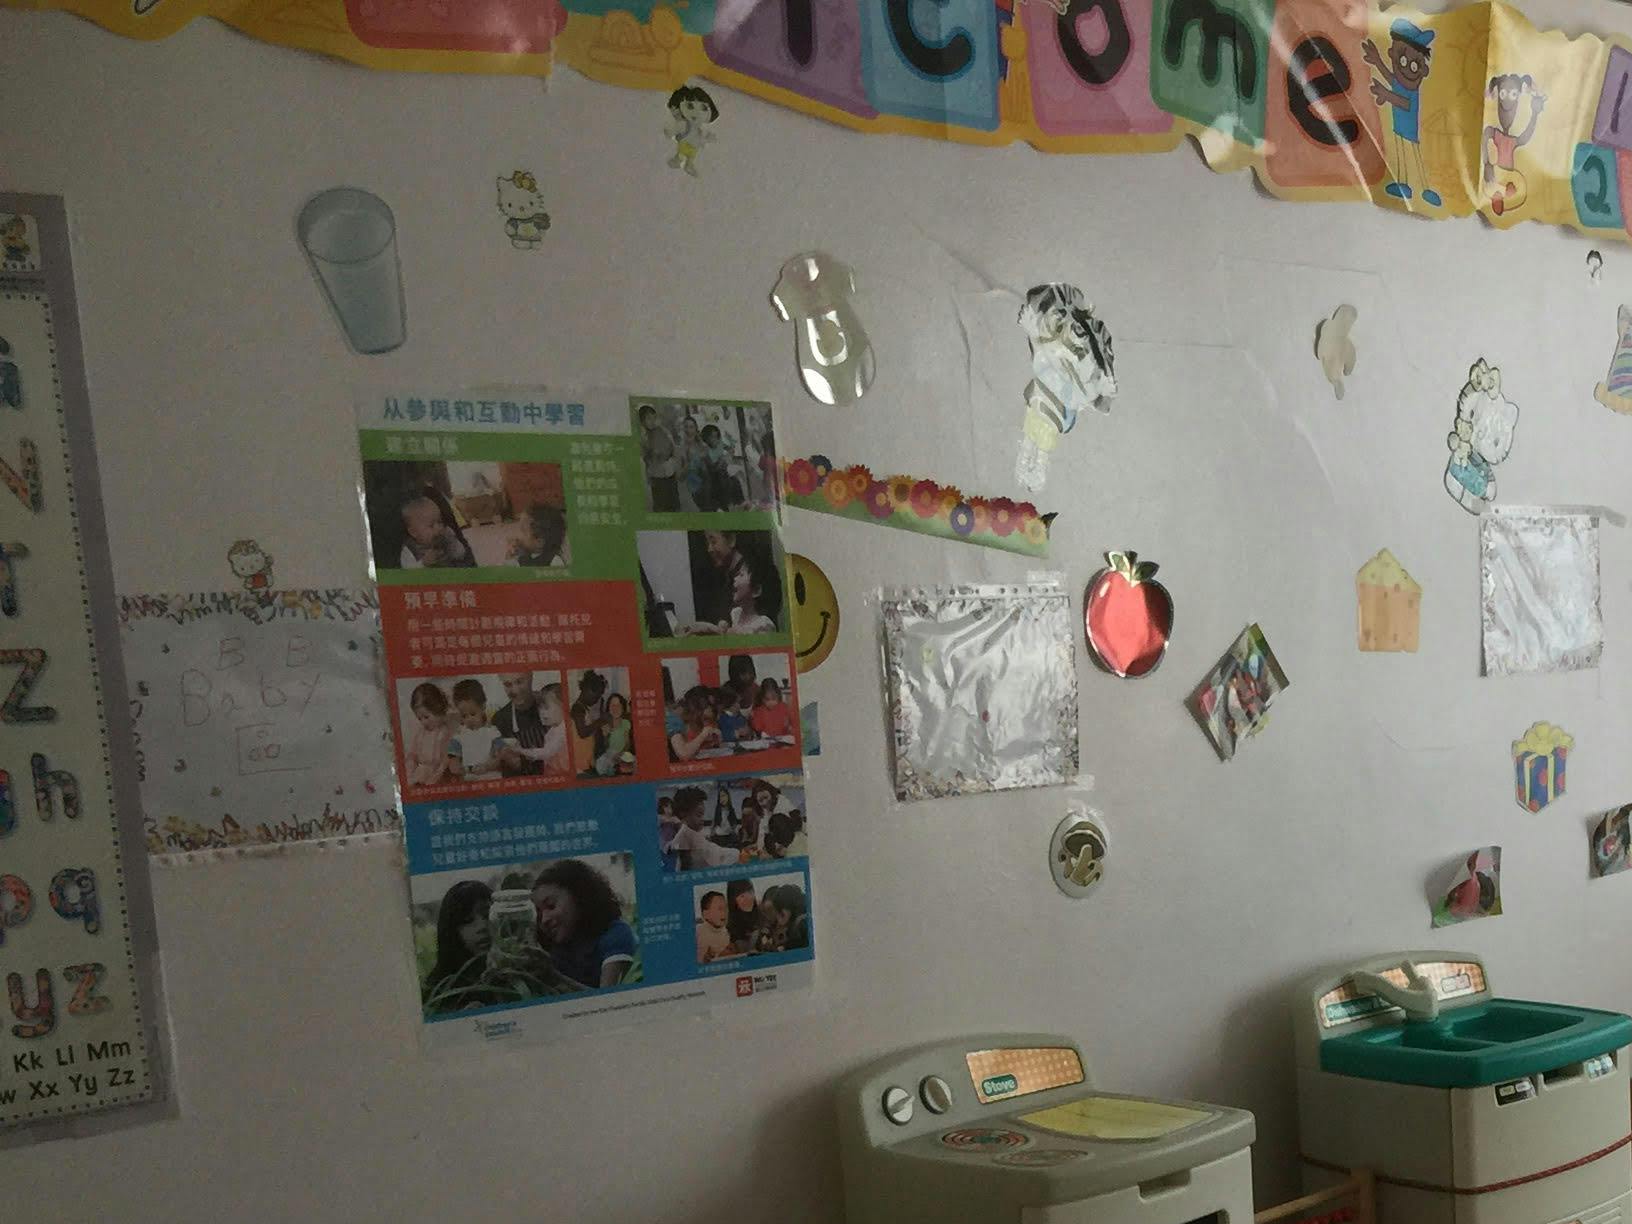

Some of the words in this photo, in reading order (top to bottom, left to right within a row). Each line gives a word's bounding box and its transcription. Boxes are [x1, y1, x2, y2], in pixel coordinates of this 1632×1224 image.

[1610, 72, 1629, 134] 1
[1583, 154, 1612, 215] 2
[0, 648, 58, 724] Z
[31, 752, 82, 820] h
[50, 867, 101, 935] q
[8, 968, 56, 1038] y
[64, 962, 110, 1016] z
[13, 1050, 44, 1073] Kk
[86, 1041, 131, 1061] Mm
[29, 1080, 60, 1101] Xx
[68, 1073, 98, 1096] Yy
[107, 1067, 136, 1088] Zz
[984, 1080, 1016, 1095] Stove
